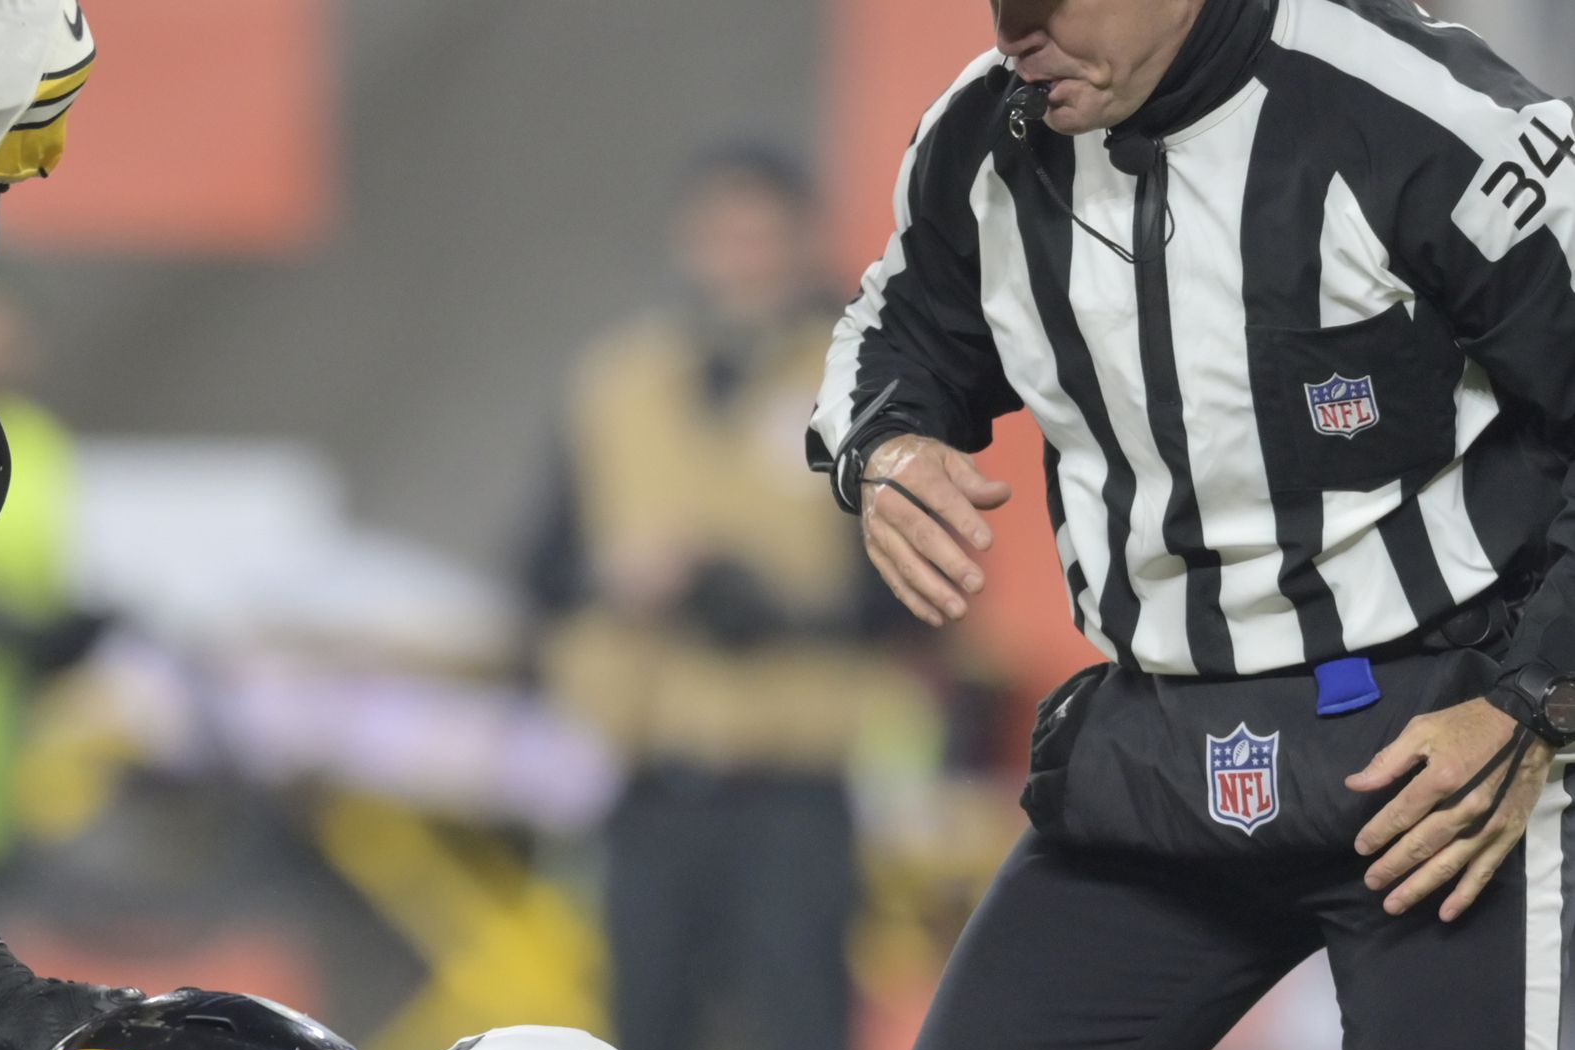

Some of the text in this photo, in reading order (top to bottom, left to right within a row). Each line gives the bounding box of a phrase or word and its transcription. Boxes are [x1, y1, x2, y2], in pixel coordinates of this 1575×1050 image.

[1479, 116, 1575, 231] 34
[1317, 399, 1371, 429] NFL
[1217, 772, 1271, 818] NFL
